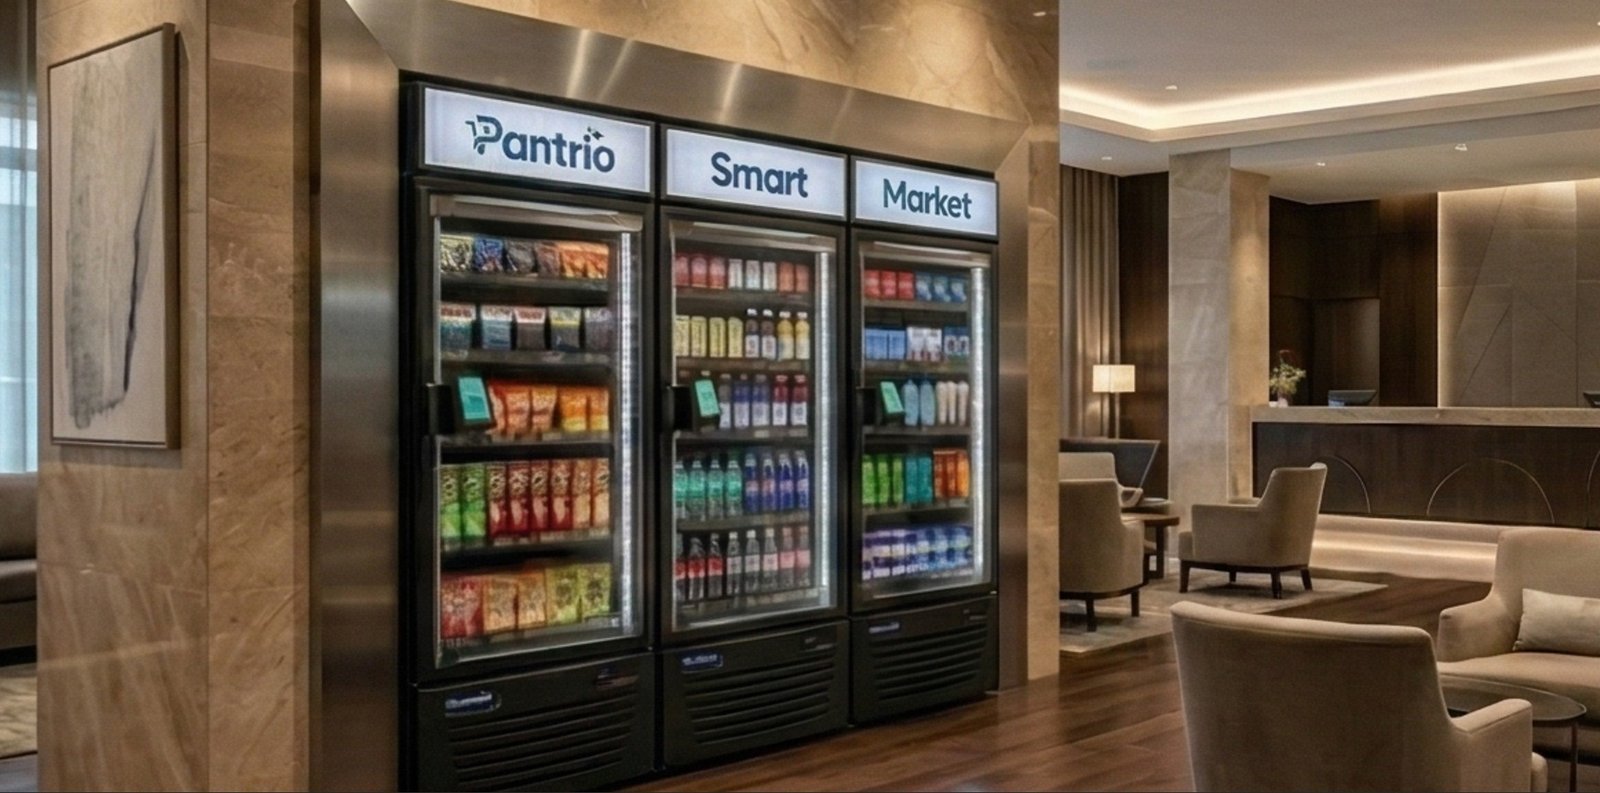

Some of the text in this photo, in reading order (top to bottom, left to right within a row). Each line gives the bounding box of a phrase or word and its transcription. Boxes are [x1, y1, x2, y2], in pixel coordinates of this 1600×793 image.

[465, 114, 615, 173] Pantrio
[711, 151, 809, 198] Smart
[883, 178, 973, 220] Market
